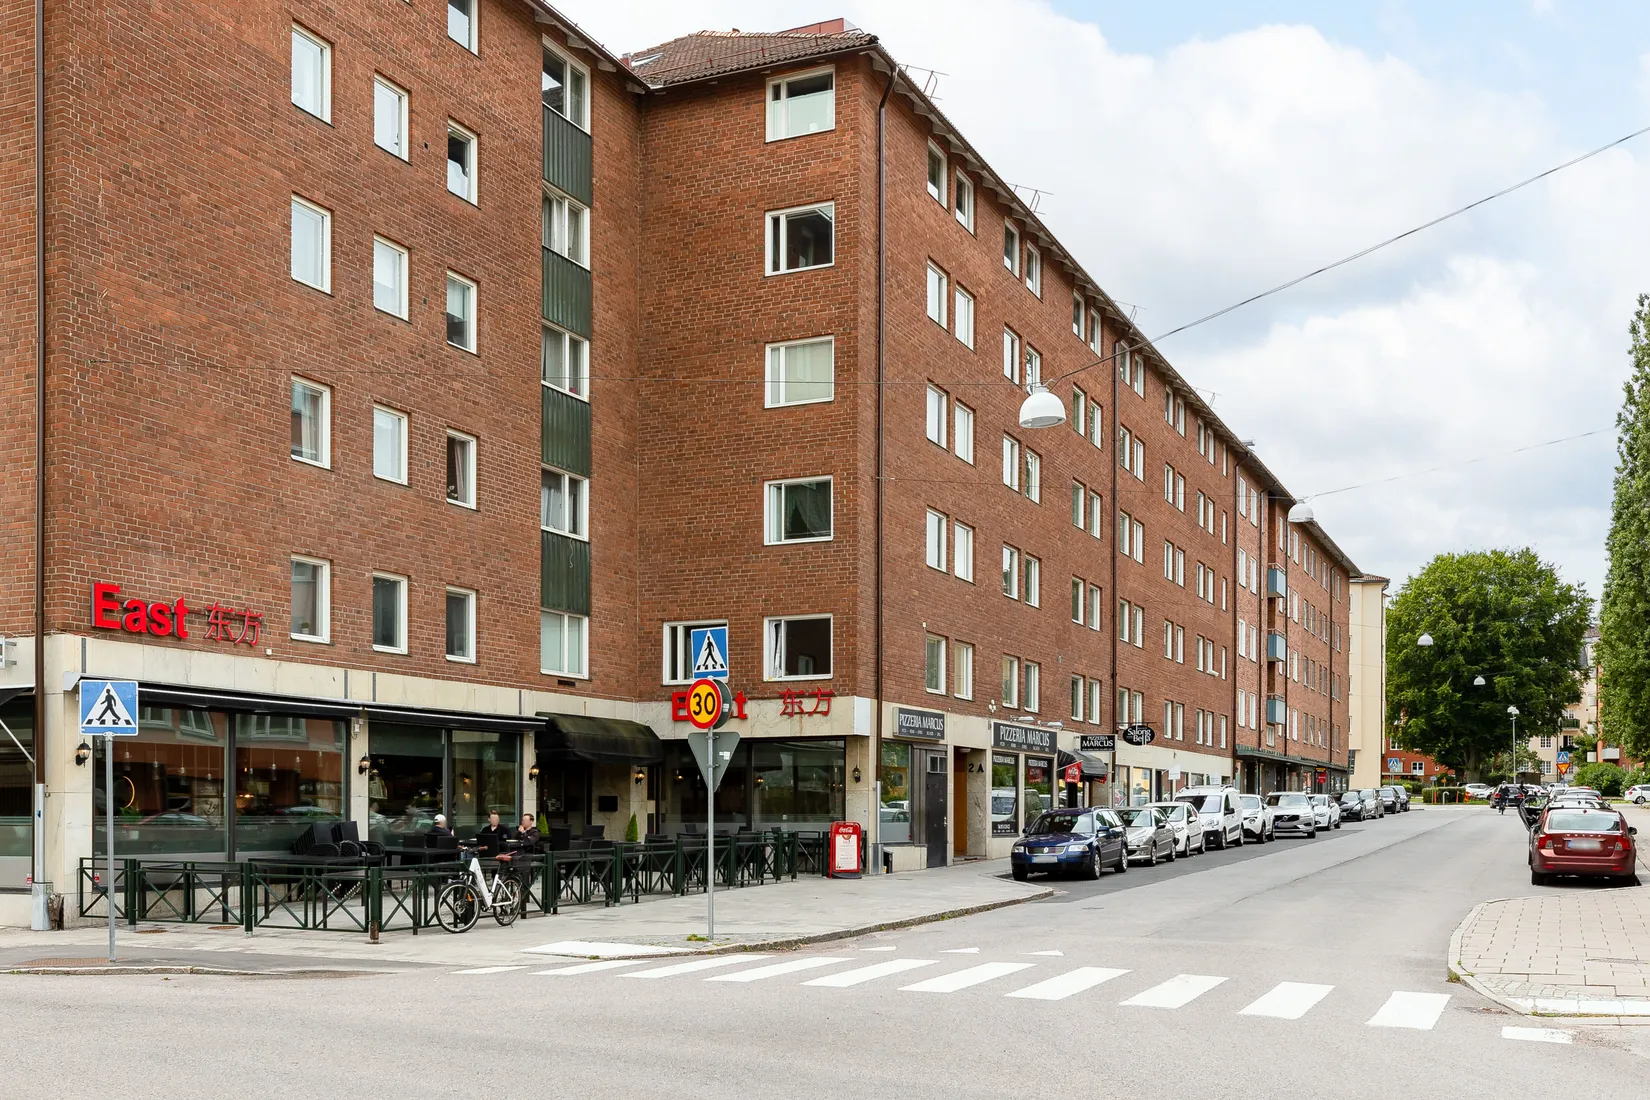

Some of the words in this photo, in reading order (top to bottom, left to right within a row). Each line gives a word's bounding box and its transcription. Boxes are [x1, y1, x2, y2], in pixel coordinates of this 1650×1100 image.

[91, 582, 188, 639] East
[205, 601, 263, 646] 东方
[672, 690, 748, 721] Et
[693, 692, 716, 716] 30
[778, 687, 834, 717] 东方
[900, 713, 921, 728] PIZZERIA
[922, 716, 944, 731] MARCUS
[1127, 724, 1151, 737] Salong
[1000, 725, 1026, 743] PIZZERIA
[1027, 730, 1050, 747] MARCUS
[968, 763, 975, 773] 2
[977, 763, 985, 773] A
